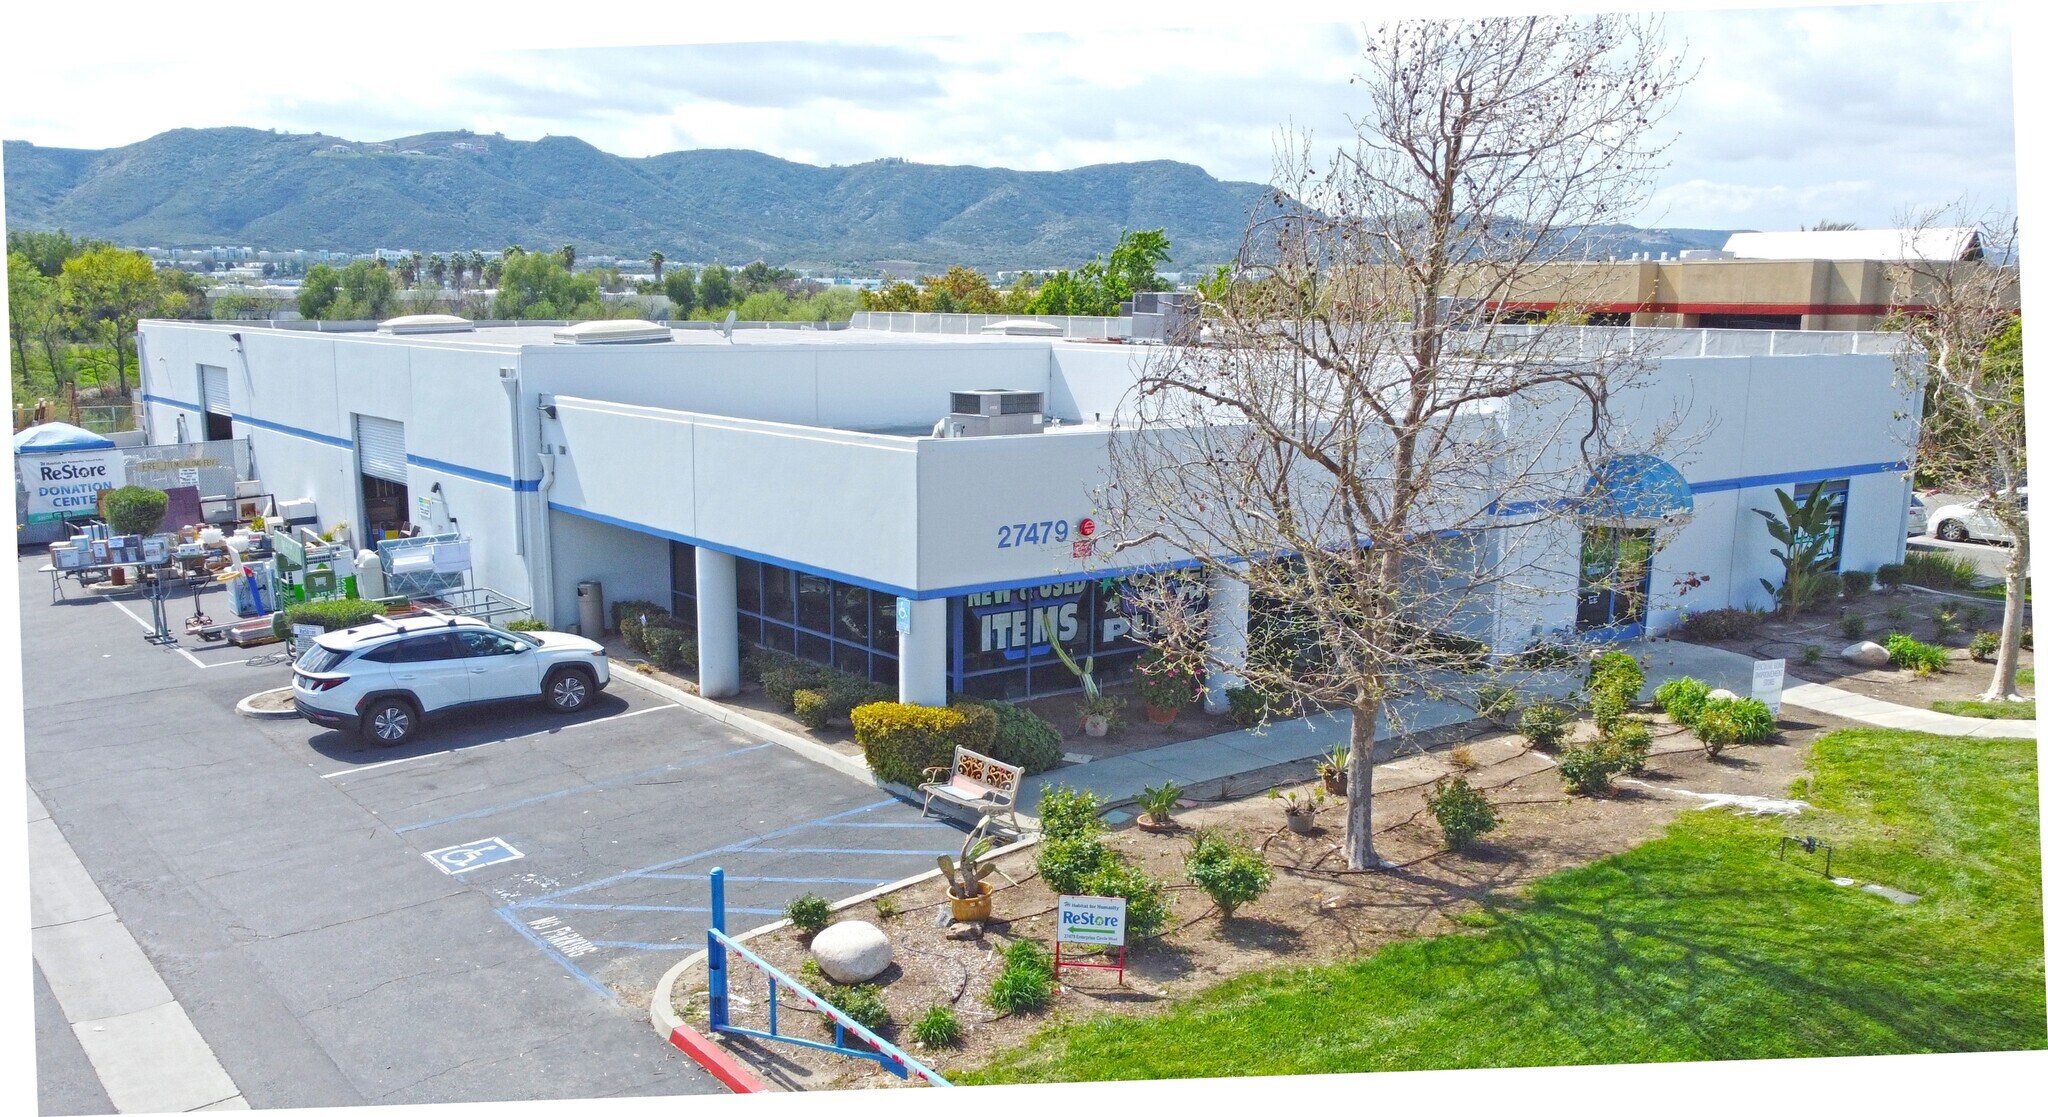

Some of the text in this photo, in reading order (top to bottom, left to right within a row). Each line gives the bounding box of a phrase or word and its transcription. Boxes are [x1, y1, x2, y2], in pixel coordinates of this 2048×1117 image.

[203, 459, 218, 467] FEN
[40, 465, 106, 480] ReStore
[39, 481, 112, 496] DONATION
[52, 494, 97, 507] CENTE
[997, 519, 1069, 549] 27479
[967, 588, 1012, 608] NEW
[1039, 580, 1088, 599] USED
[981, 601, 1079, 652] ITEMS
[1063, 911, 1119, 927] ReStore
[526, 915, 599, 958] NO PARKING
